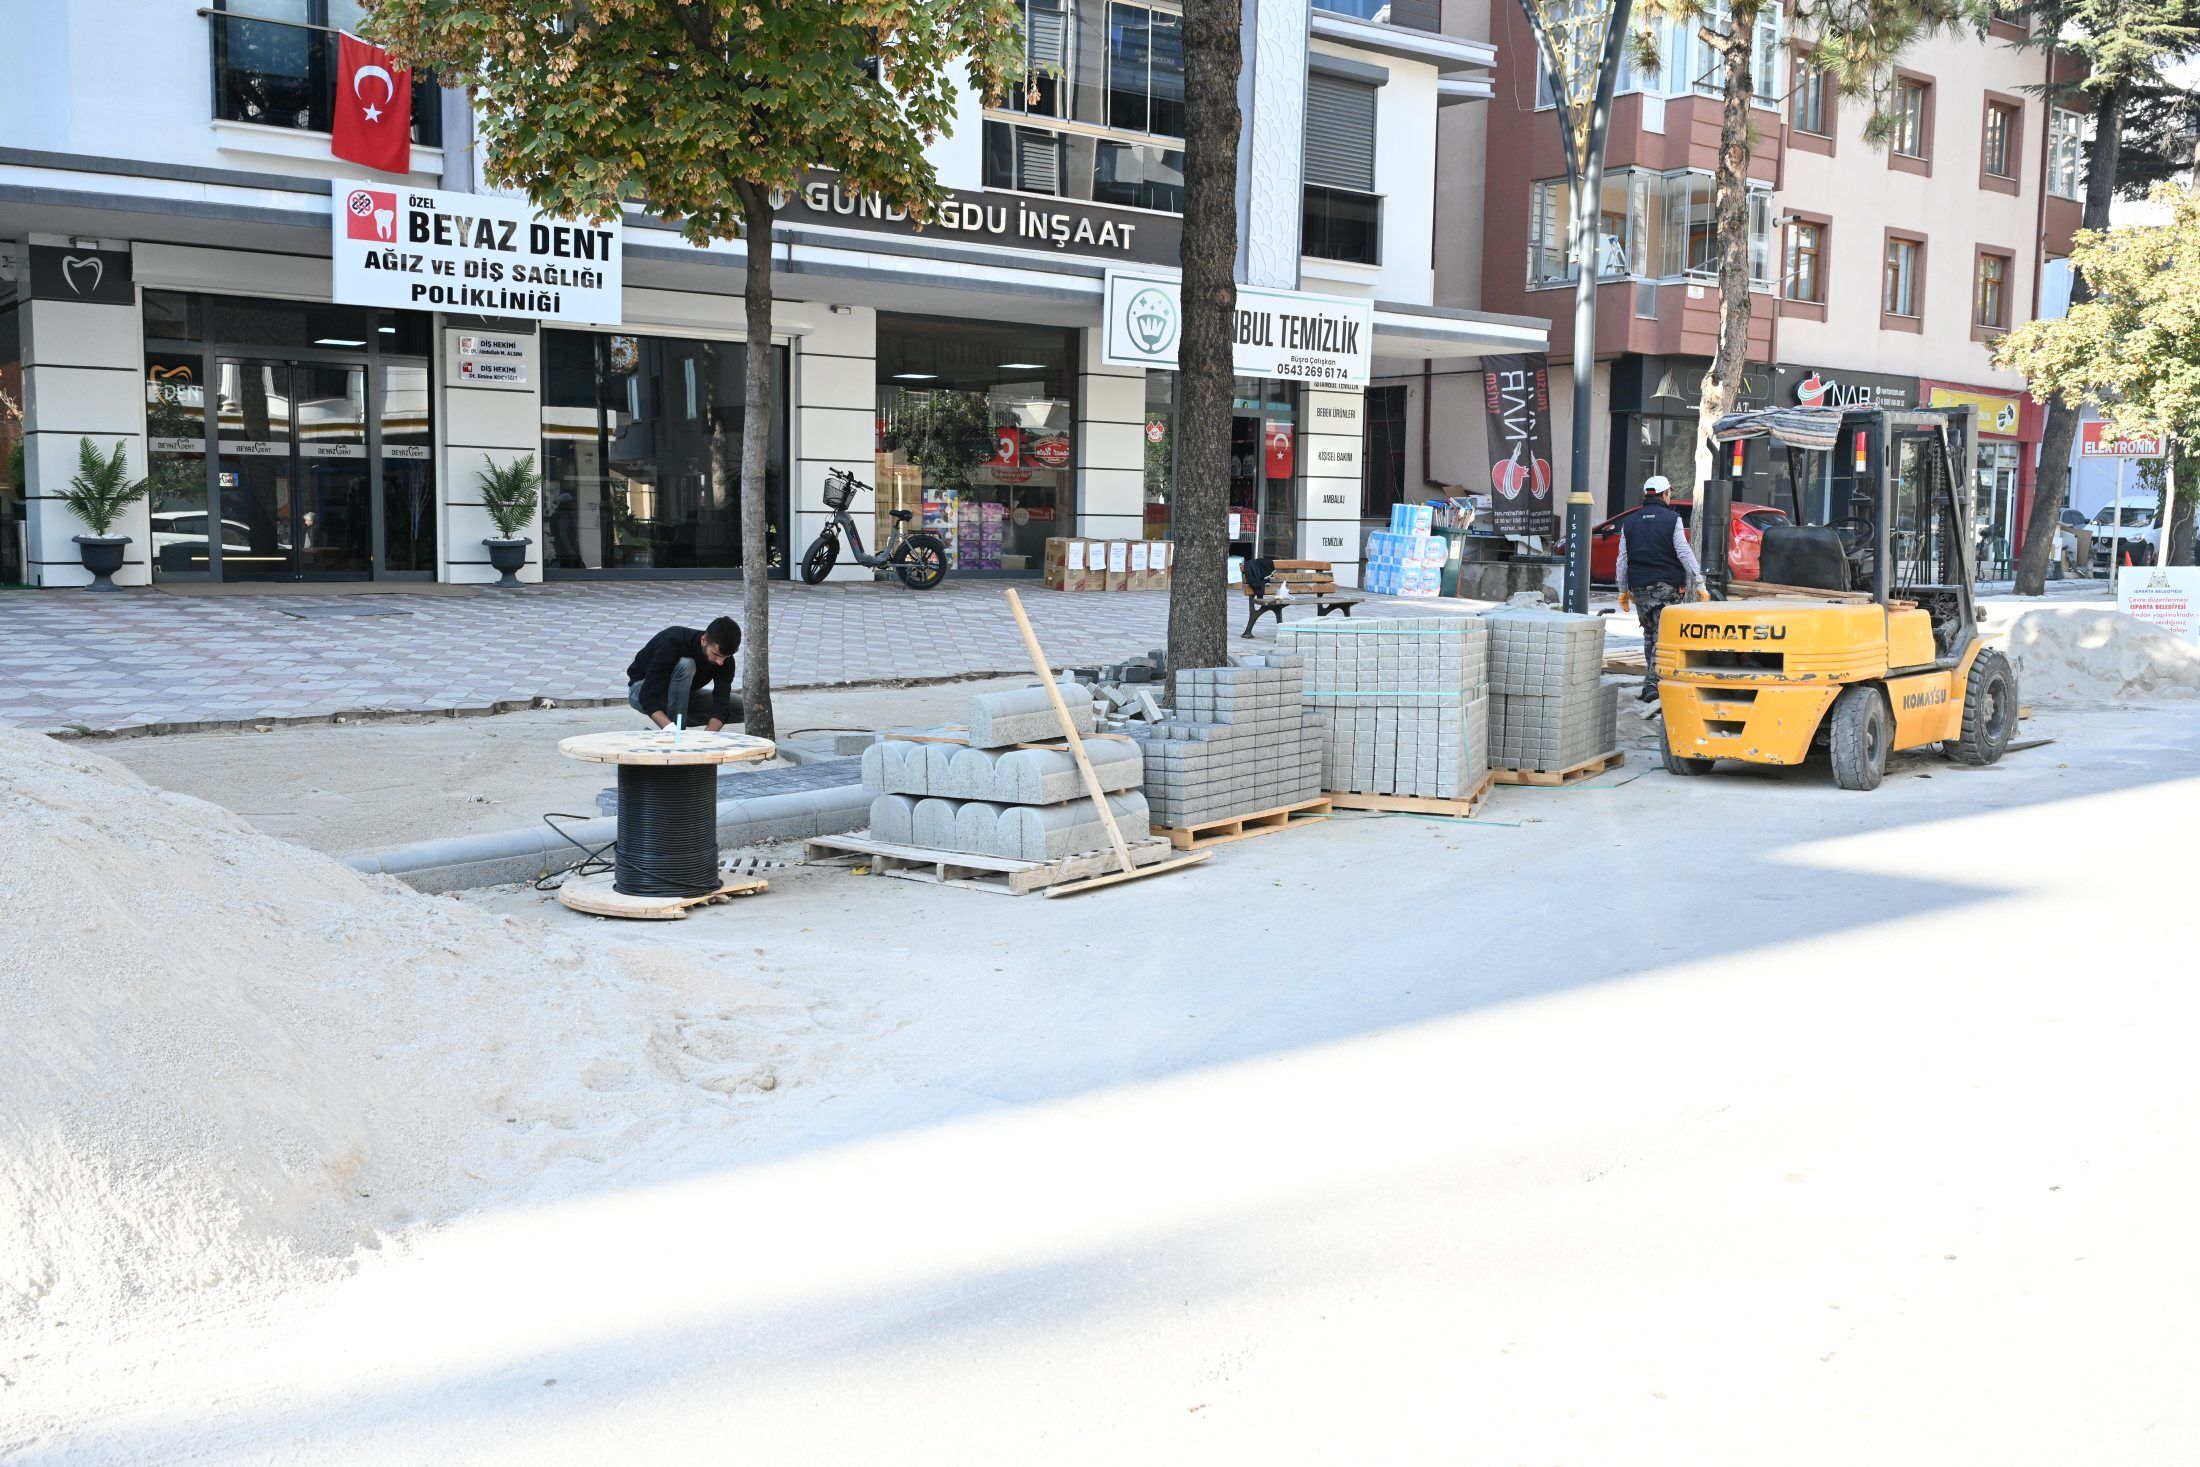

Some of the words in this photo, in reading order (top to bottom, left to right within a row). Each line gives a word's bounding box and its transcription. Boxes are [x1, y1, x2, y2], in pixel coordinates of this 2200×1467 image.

[408, 193, 436, 210] ÖZEL
[1019, 201, 1136, 250] İNŞAAT
[408, 210, 518, 253] BEYAZ
[529, 223, 614, 262] DENT
[364, 248, 424, 273] AĞIZ
[431, 259, 455, 276] VE
[464, 257, 504, 282] DİŞ
[512, 263, 603, 290] SAĞLIĞI
[411, 283, 561, 313] POLİKLİNİĞİ
[1279, 312, 1360, 355] TEMİZLİK
[480, 340, 492, 348] DİŞ
[493, 341, 516, 349] HEKİMİ
[480, 365, 492, 373] DİŞ
[1290, 355, 1309, 364] Büşra
[1309, 357, 1336, 366] Çalışkan
[1277, 363, 1303, 376] 0543
[1304, 366, 1323, 378] 269
[1324, 367, 1335, 379] 61
[1336, 369, 1348, 380] 74
[1317, 407, 1332, 418] BEBEK
[1332, 407, 1356, 419] ÜRÜNLERİ
[1336, 452, 1353, 462] BAKIM
[1323, 494, 1345, 504] AMBALAJ
[1322, 537, 1344, 547] TEMİZLİK
[1569, 513, 1577, 578] ISPARTA
[1679, 623, 1787, 640] KOMATSU
[1903, 689, 1947, 711] KOMATSU
